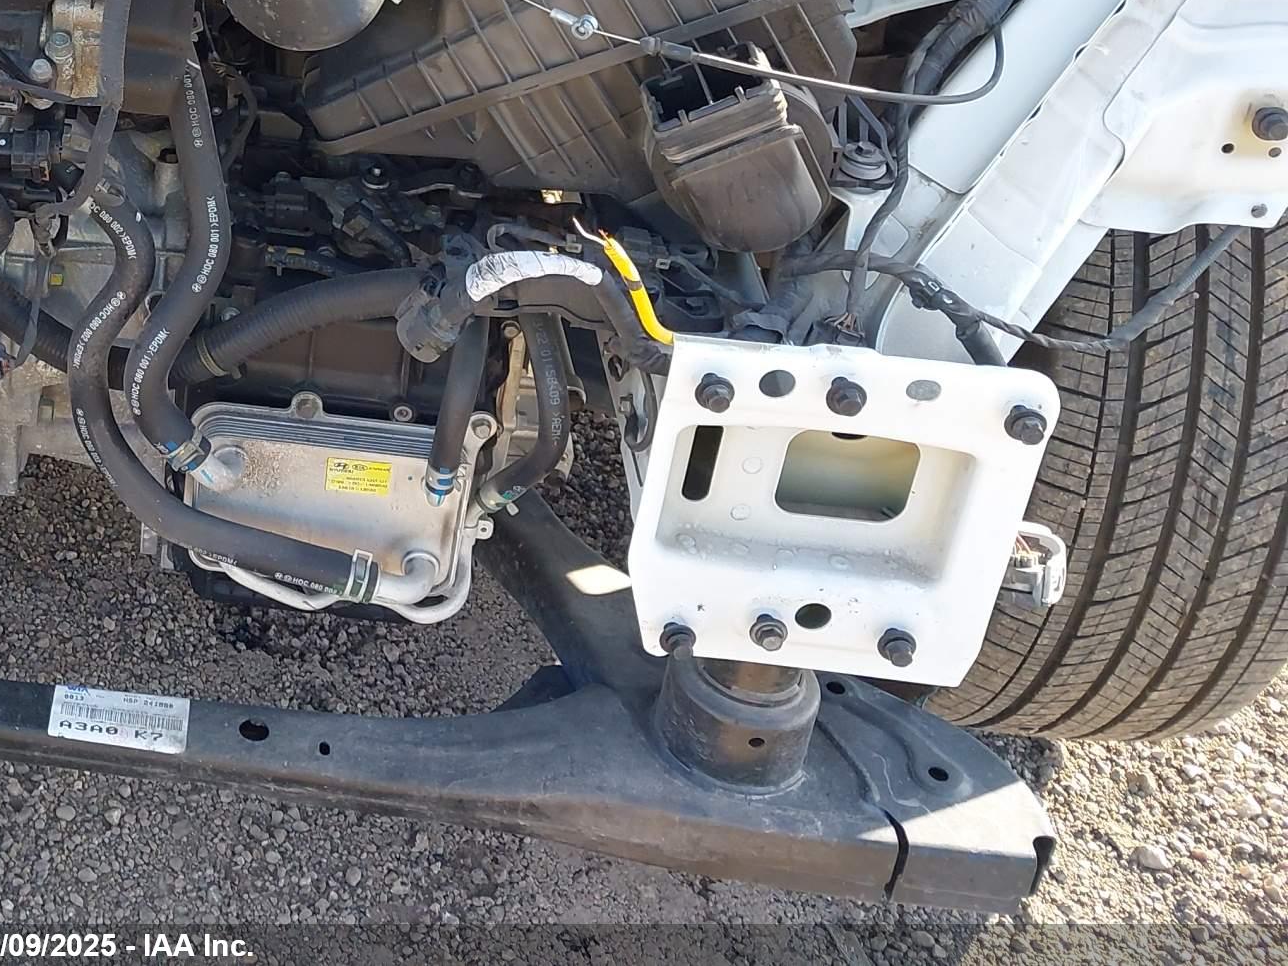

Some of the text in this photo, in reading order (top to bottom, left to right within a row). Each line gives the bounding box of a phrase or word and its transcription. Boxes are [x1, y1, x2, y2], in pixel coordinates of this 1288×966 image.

[89, 201, 101, 213] OC
[99, 210, 113, 223] 080
[110, 221, 124, 235] 002
[210, 229, 220, 243] 001
[208, 244, 219, 258] 080
[201, 258, 215, 276] HOC
[99, 302, 114, 319] HOC
[89, 317, 101, 330] 080
[81, 328, 93, 342] 002
[134, 368, 144, 383] 080
[139, 355, 152, 370] 001
[59, 719, 164, 742] A3A0 K7
